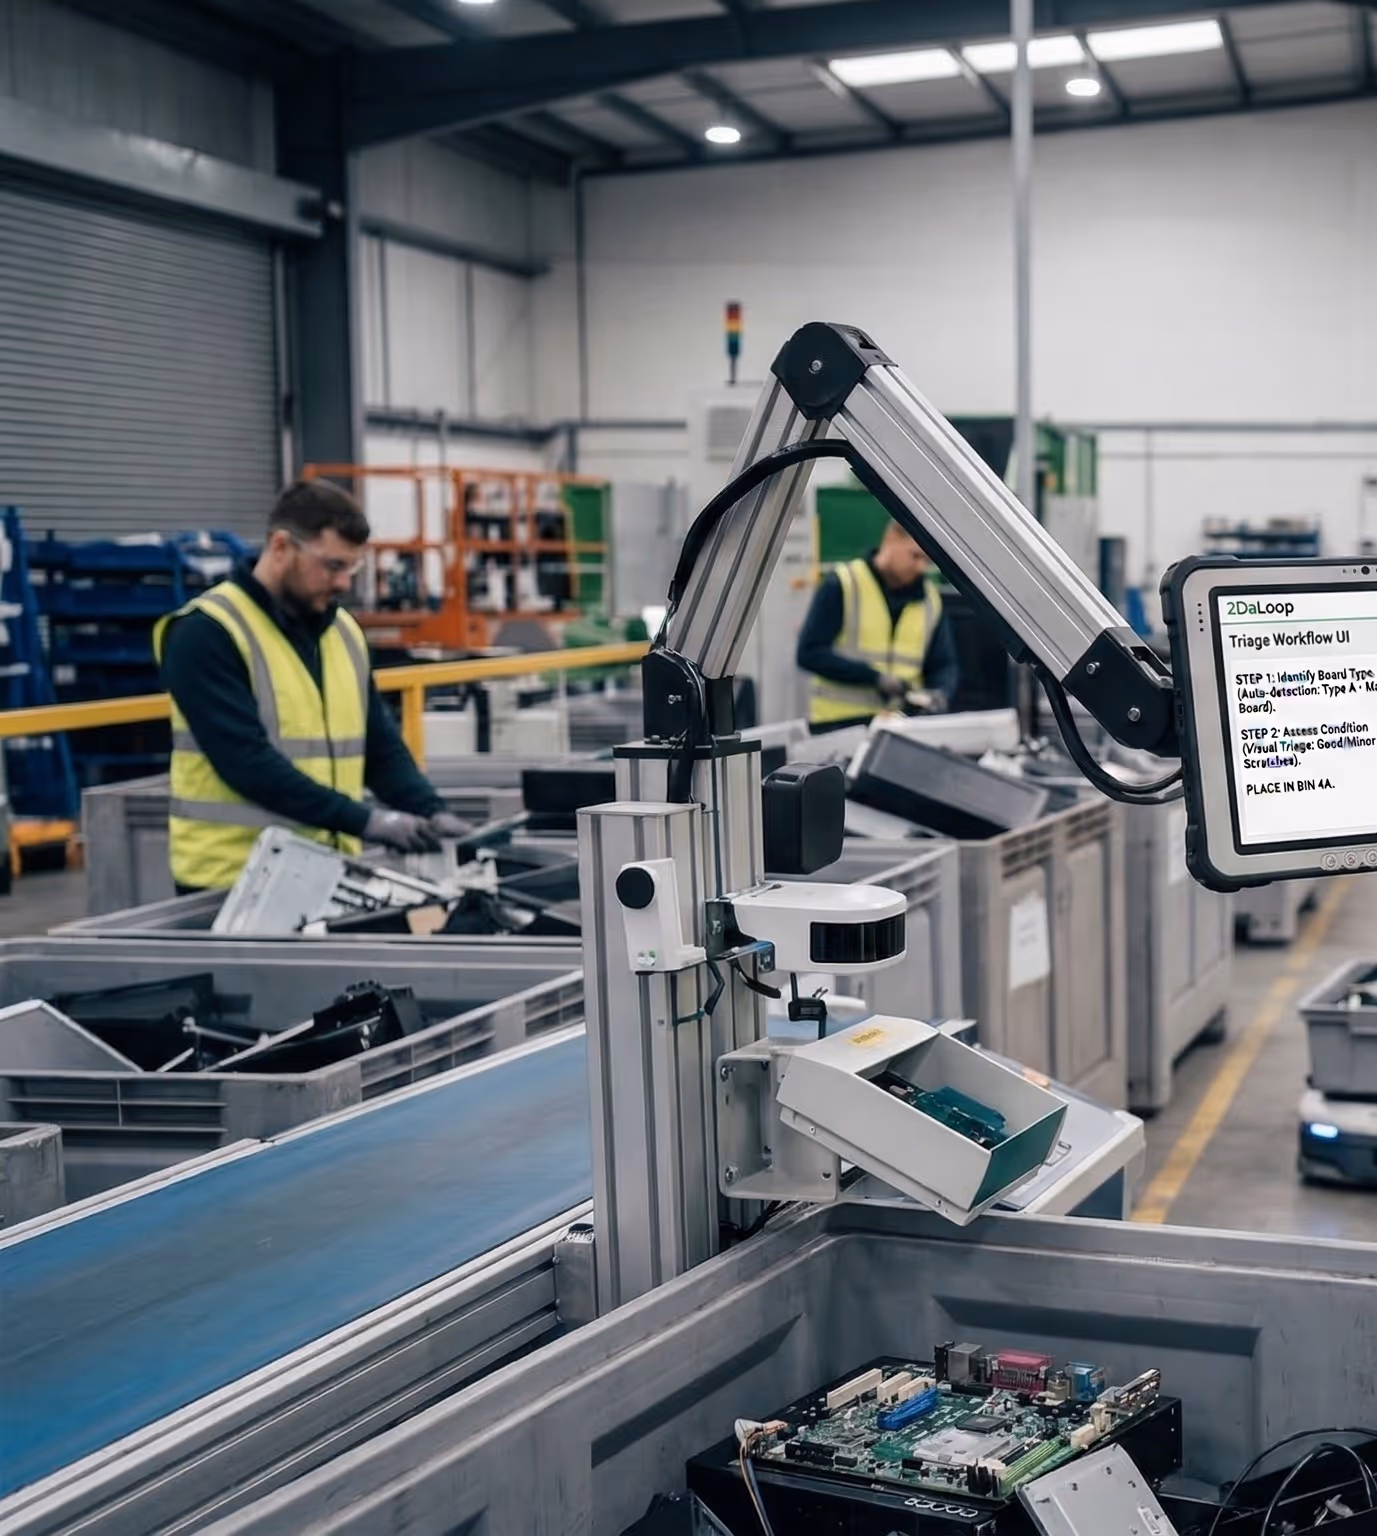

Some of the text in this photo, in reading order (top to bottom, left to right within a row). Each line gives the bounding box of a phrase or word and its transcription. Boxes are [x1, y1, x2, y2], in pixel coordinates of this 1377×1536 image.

[1226, 600, 1294, 617] 2DaLoop
[1229, 630, 1350, 650] Triage Workflow UI
[1235, 673, 1263, 685] STEP
[1266, 673, 1275, 683] 1:
[1317, 668, 1347, 681] Board
[1321, 683, 1346, 698] Type
[1348, 682, 1357, 693] A
[1238, 700, 1276, 714] Board).
[1240, 727, 1268, 740] STEP
[1242, 741, 1278, 757] (Visual
[1246, 778, 1335, 795] PLACE IN BIN 4A.
